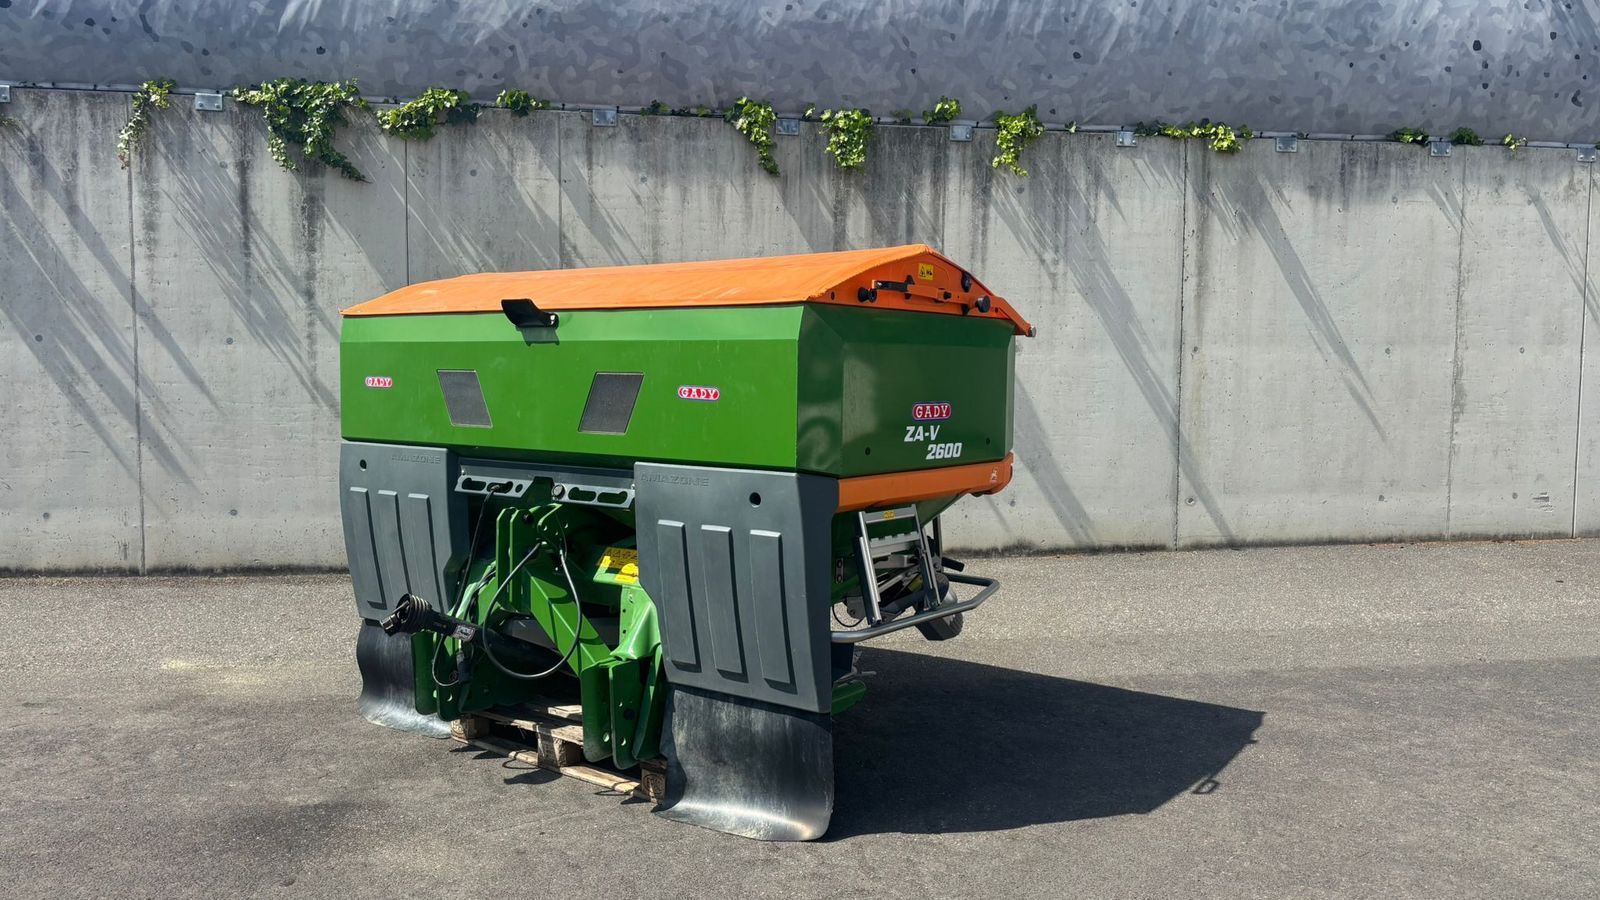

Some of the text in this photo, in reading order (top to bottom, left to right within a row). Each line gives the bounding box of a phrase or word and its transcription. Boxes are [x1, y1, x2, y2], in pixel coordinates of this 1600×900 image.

[367, 377, 391, 387] GADY
[682, 387, 717, 399] GADY
[915, 405, 948, 418] GADY
[904, 425, 940, 442] ZA-V
[925, 442, 962, 460] 2600
